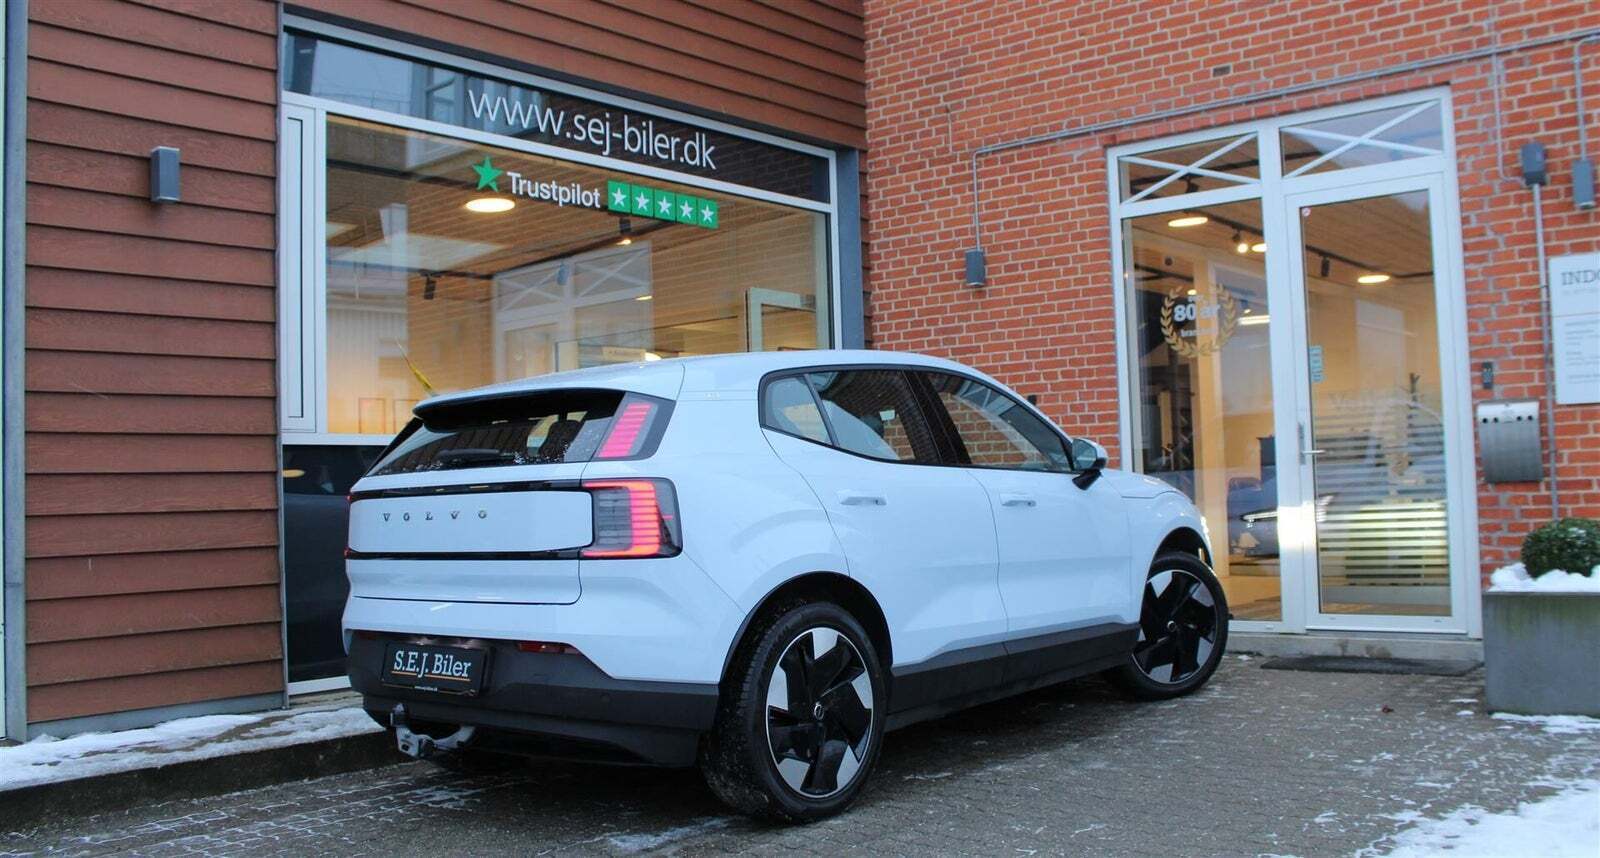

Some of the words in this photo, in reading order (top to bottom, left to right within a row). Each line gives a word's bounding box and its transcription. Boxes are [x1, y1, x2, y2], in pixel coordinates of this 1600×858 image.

[468, 89, 717, 170] www.sej-biler.dk
[507, 171, 601, 208] Trustpilot
[1173, 303, 1196, 322] 80
[383, 510, 487, 522] VOLVO
[393, 650, 429, 678] S.E.J.
[432, 653, 472, 677] Biler
